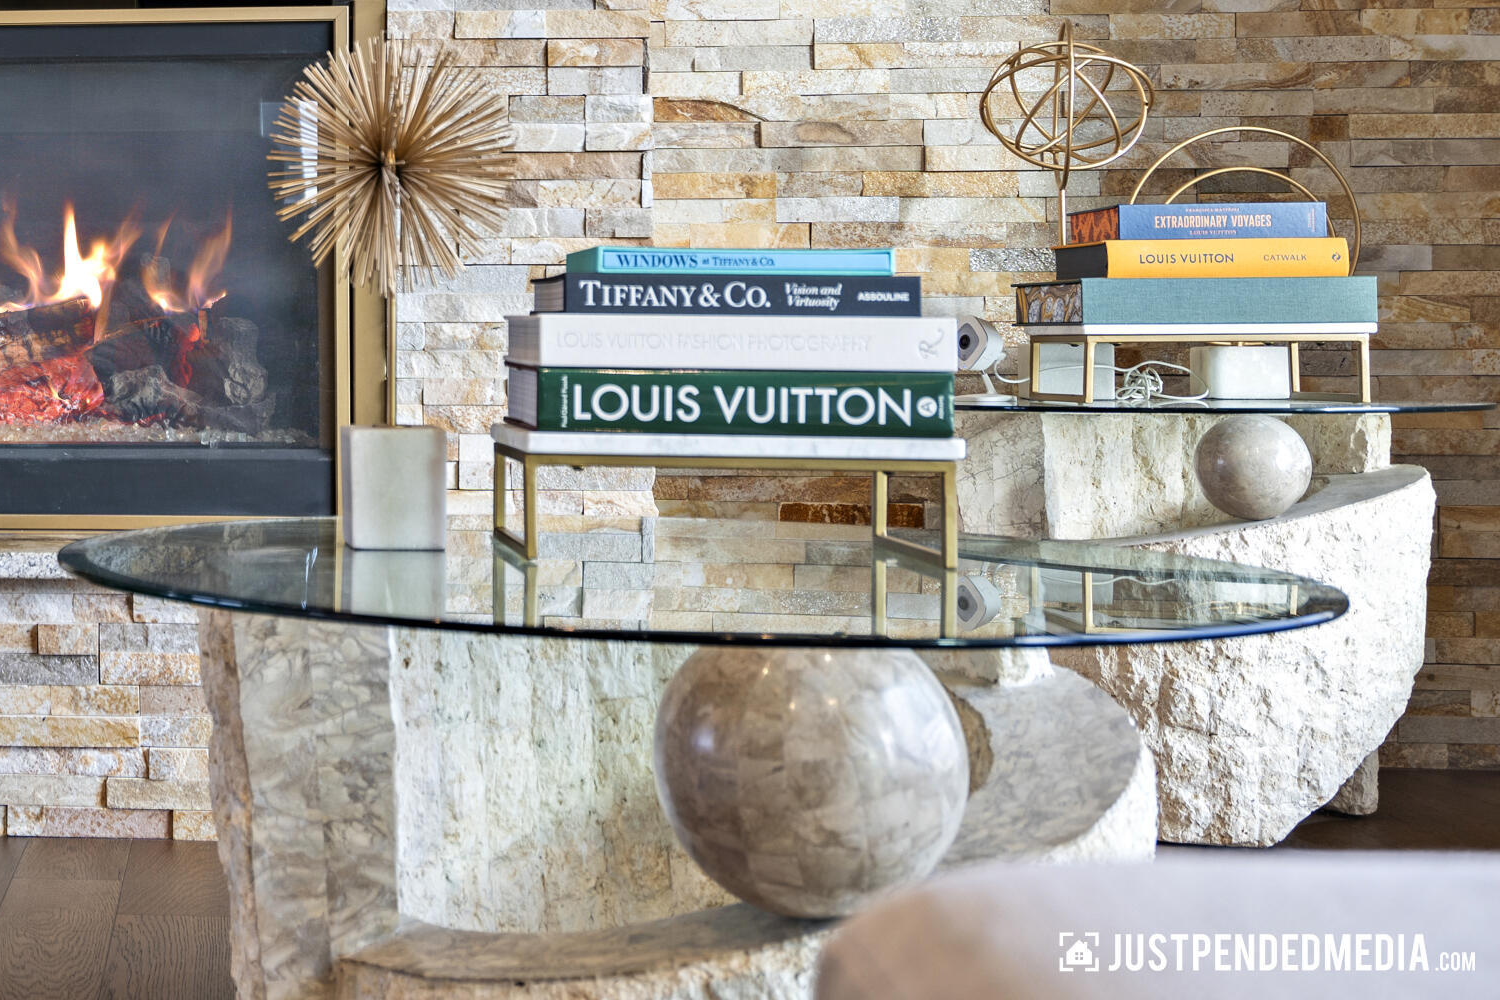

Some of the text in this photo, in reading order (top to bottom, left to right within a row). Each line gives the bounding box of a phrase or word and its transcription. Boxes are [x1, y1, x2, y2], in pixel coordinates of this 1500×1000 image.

[1154, 214, 1272, 229] EXTRAORDINARY VOYAGES
[616, 254, 698, 268] WINDOWS
[1139, 254, 1177, 264] LOUIS
[1180, 253, 1234, 264] VUITTON
[785, 282, 842, 295] Vision and
[787, 295, 840, 311] Virtuosity
[857, 292, 910, 301] ASSOULINE
[556, 331, 873, 353] LOUIS VUITTON FASHION PHOTOGRAPHY
[572, 383, 701, 423] LOUIS
[713, 386, 912, 427] VUITTON
